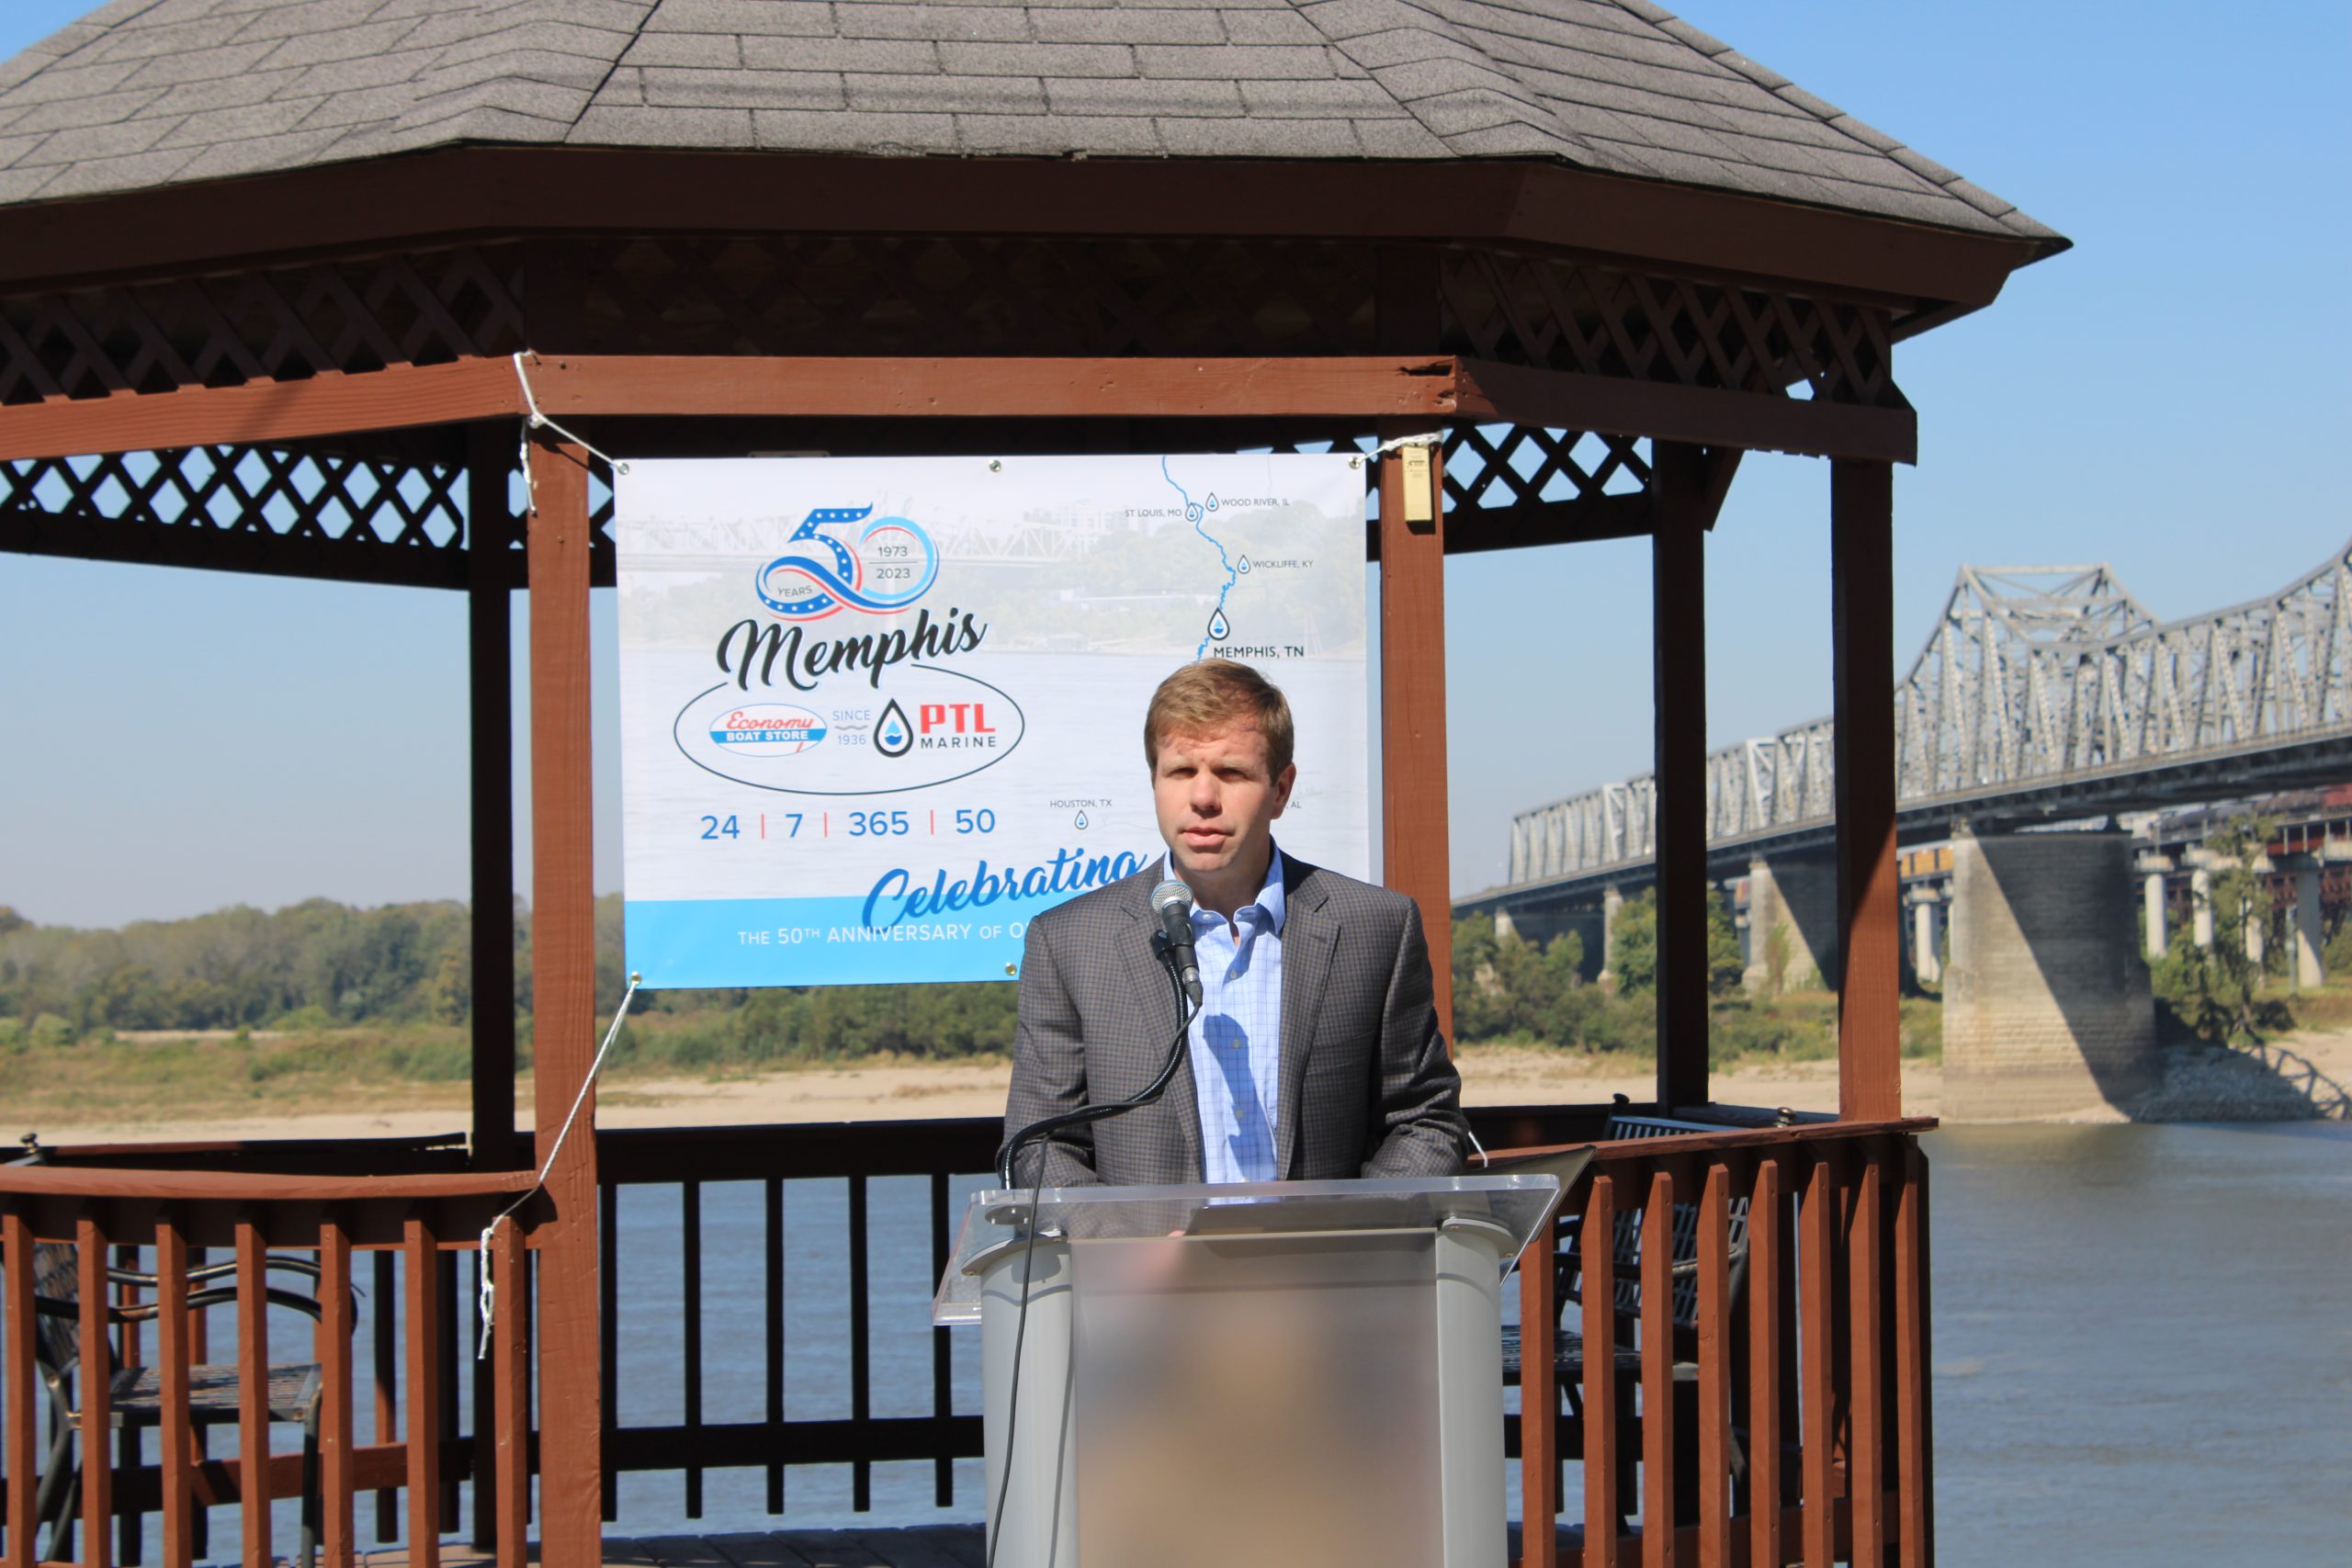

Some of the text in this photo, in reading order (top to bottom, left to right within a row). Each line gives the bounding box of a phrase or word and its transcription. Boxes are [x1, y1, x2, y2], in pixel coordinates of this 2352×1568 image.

[1253, 499, 1281, 507] RIVER,
[1137, 509, 1166, 518] LOUIS,
[1168, 509, 1182, 517] MO
[756, 501, 940, 615] 50
[876, 546, 909, 558] 1973
[1252, 560, 1301, 569] WICKLIFFE,
[876, 568, 911, 580] 2023
[777, 585, 813, 597] YEARS
[716, 607, 989, 691] Memphis
[1214, 646, 1305, 659] MEMPHIS, TN
[832, 710, 871, 720] SINCE
[920, 704, 996, 734] PTL
[726, 730, 808, 742] BOAT STORE
[838, 735, 867, 745] 1936
[921, 736, 997, 749] MARINE
[1050, 798, 1113, 809] HOUSTON, TX
[700, 808, 996, 840] 24 7 365 50
[738, 931, 770, 944] THE
[778, 928, 820, 944] 50TH
[827, 923, 971, 942] ANNIVERSARY
[979, 926, 1001, 939] OF
